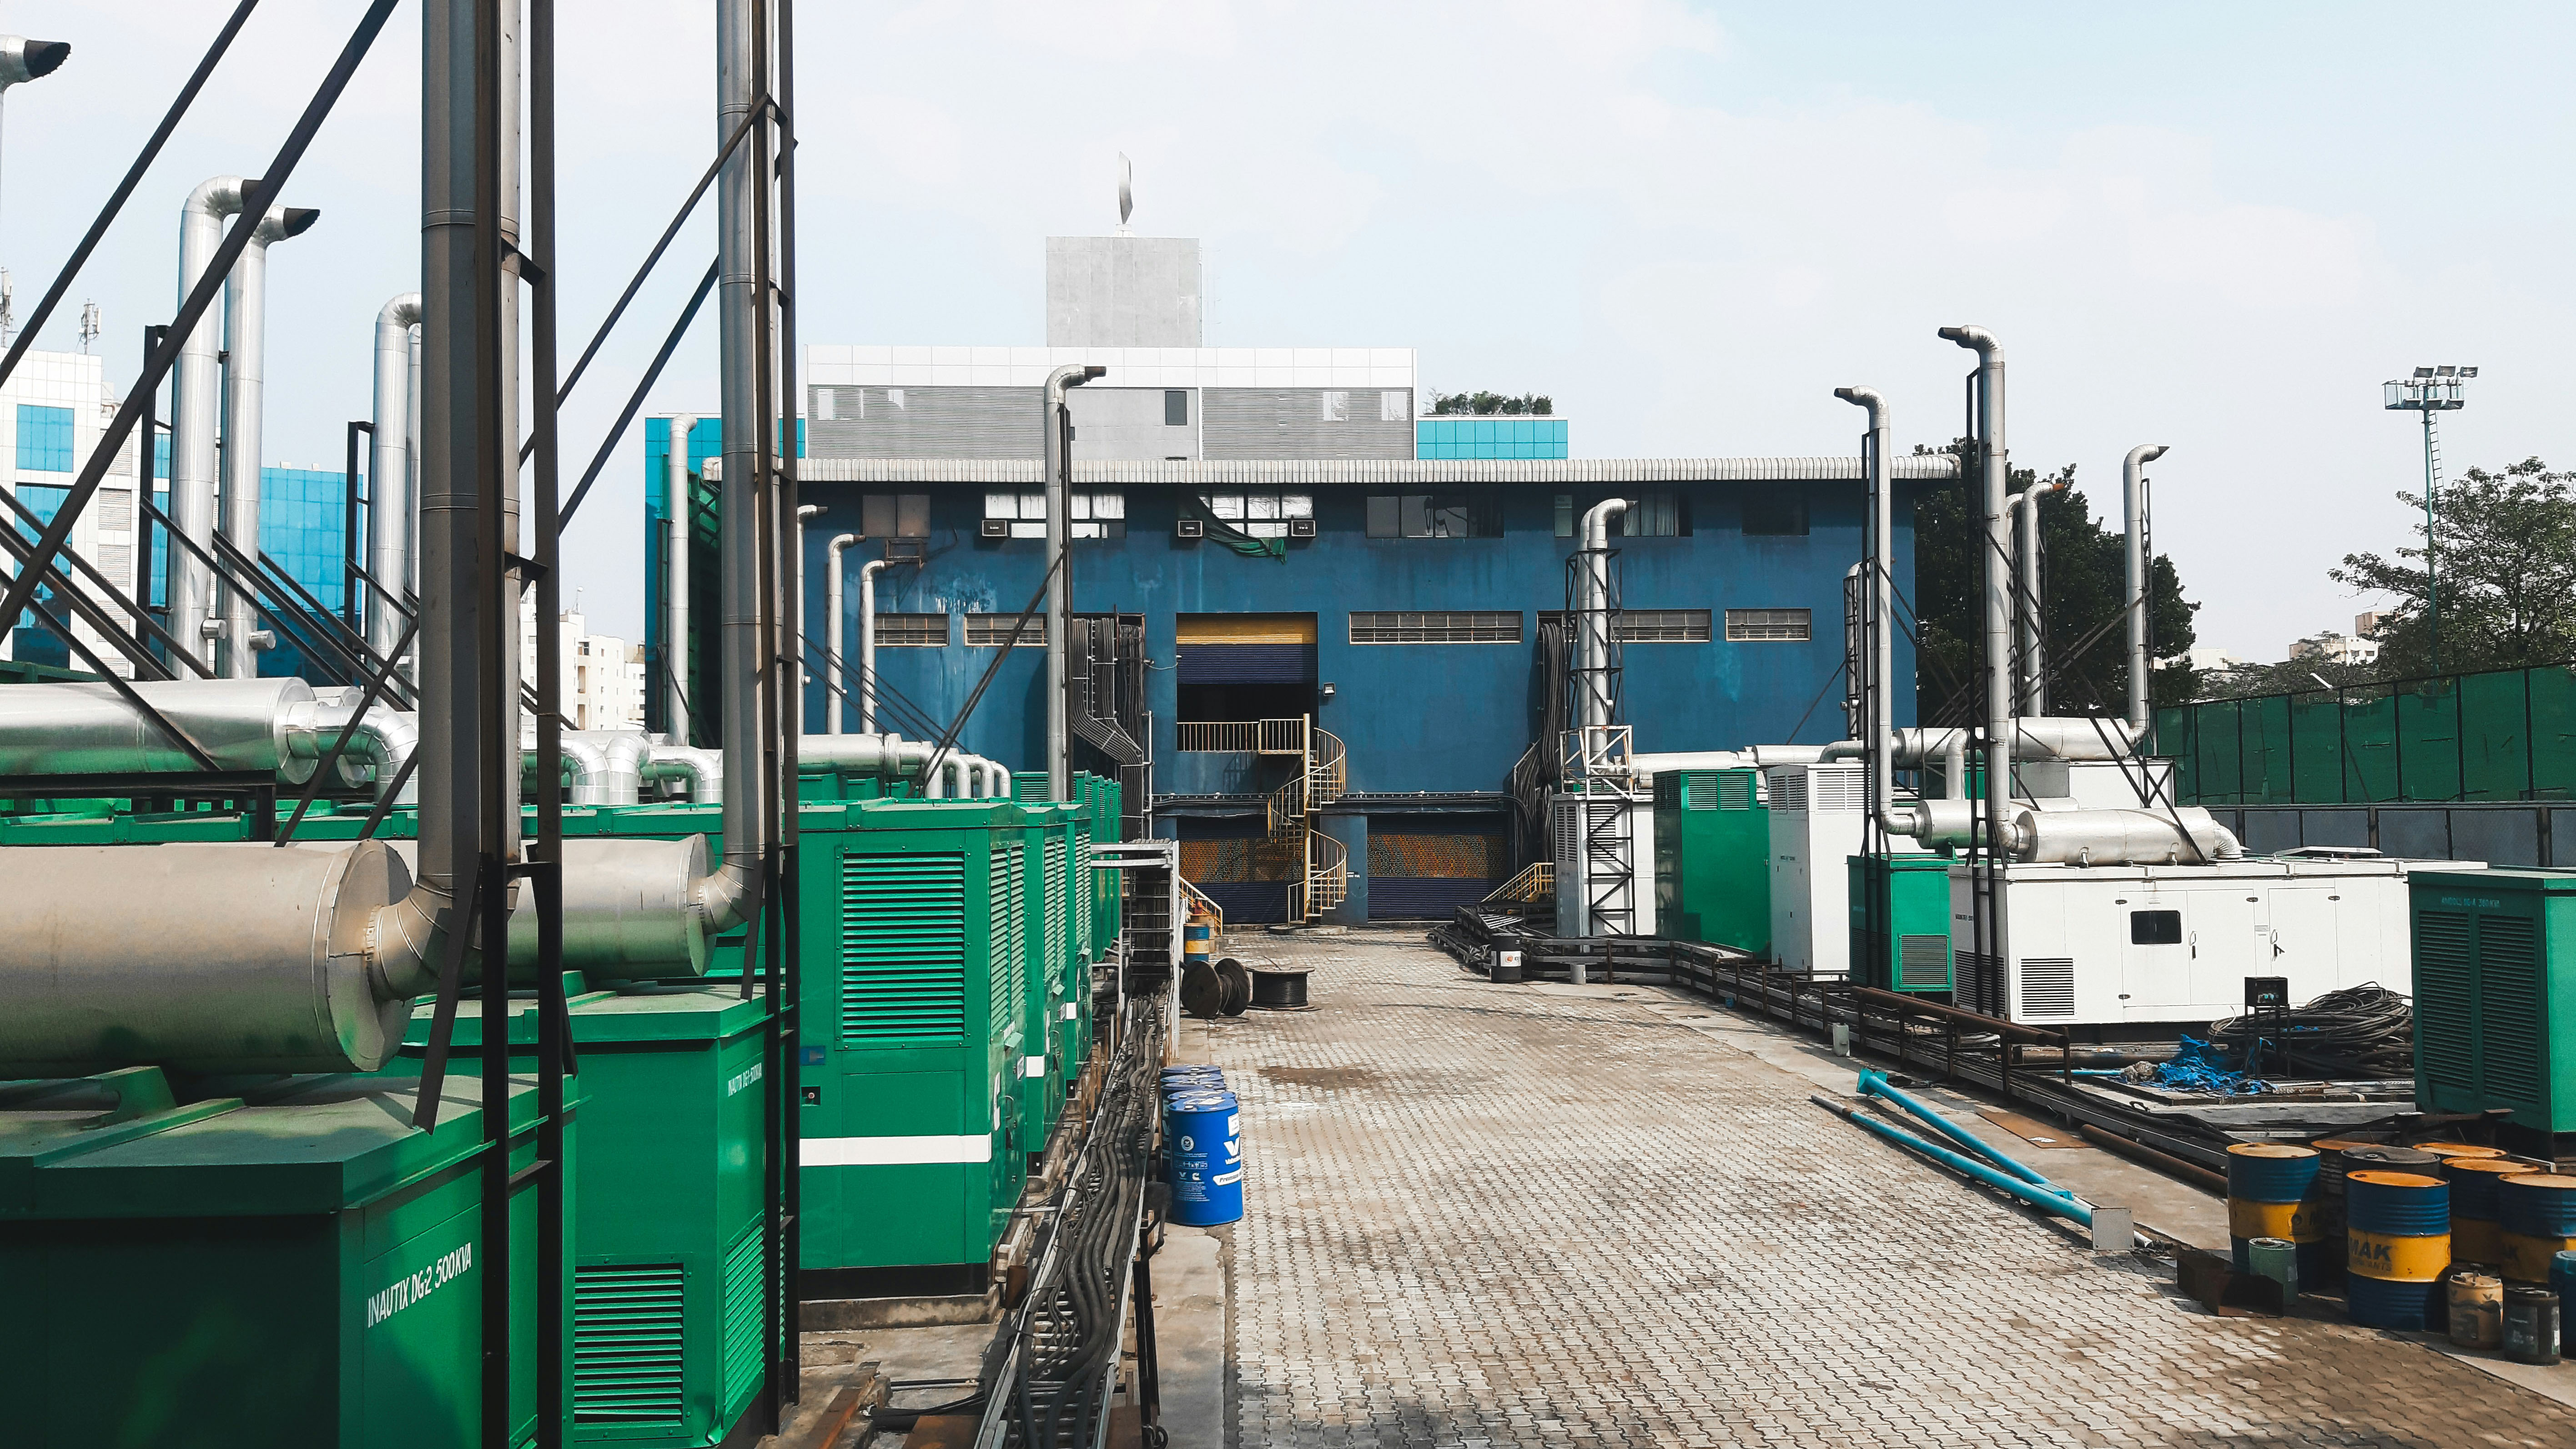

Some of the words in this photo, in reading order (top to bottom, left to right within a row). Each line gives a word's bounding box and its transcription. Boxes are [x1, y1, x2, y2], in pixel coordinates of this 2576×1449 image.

[367, 1277, 410, 1328] INAUTIX
[411, 1265, 432, 1304] DG-2
[434, 1242, 472, 1288] 500KVA
